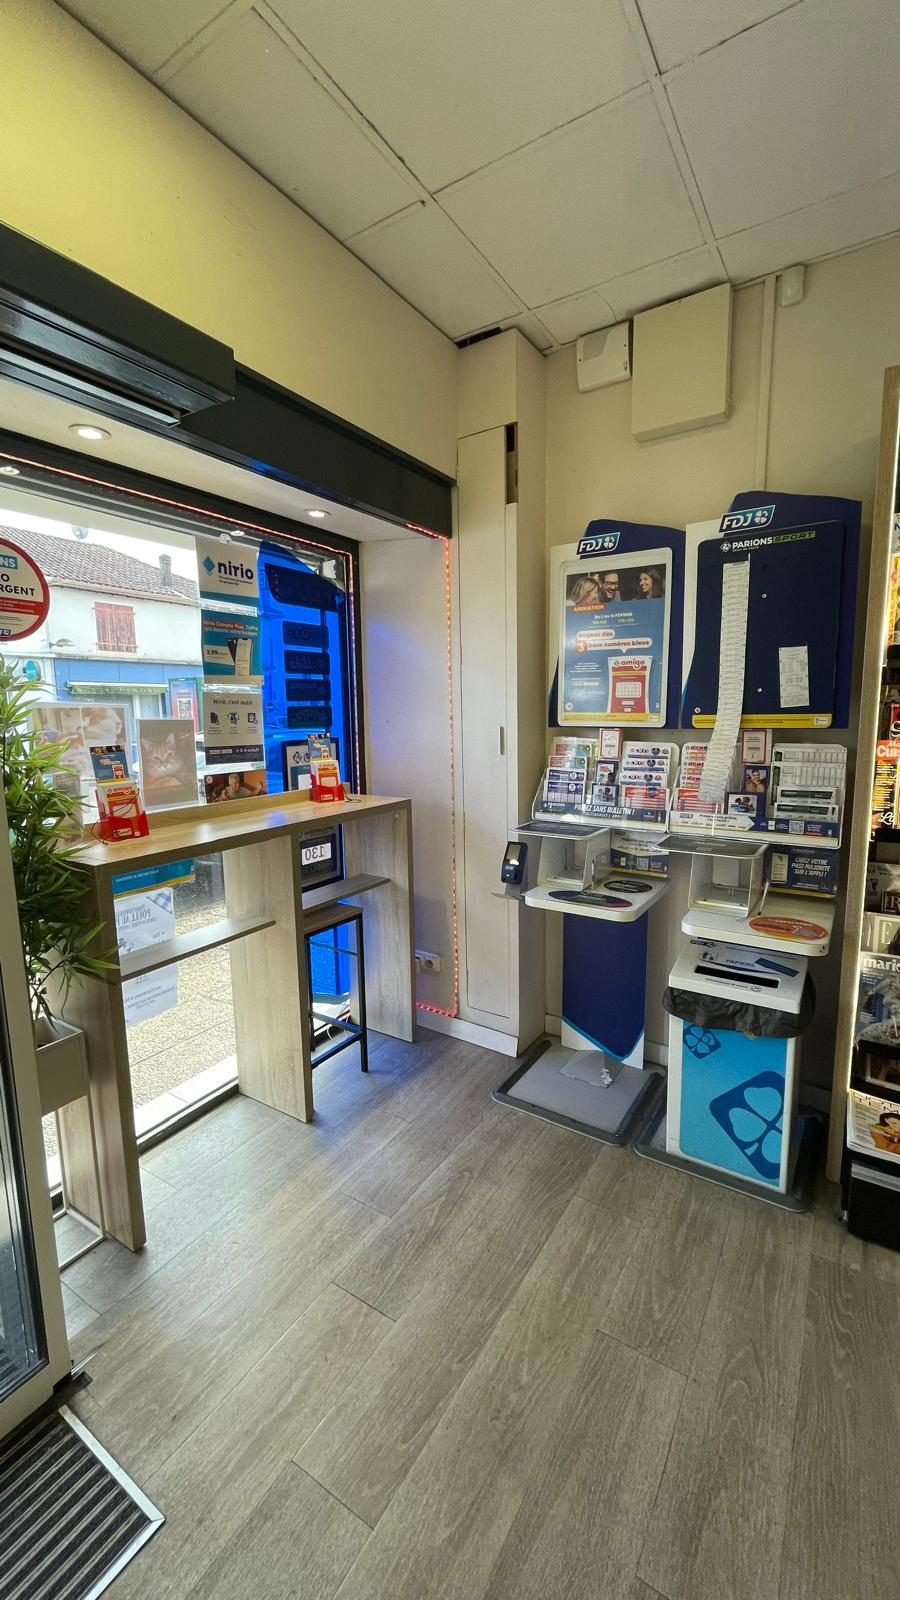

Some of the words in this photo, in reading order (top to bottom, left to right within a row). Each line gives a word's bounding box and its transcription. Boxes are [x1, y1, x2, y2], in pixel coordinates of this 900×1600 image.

[723, 512, 753, 530] FDJ
[578, 538, 603, 552] FDJ
[732, 536, 773, 550] PARIONS
[773, 532, 815, 543] SPORT
[217, 560, 254, 580] nirio
[621, 658, 645, 671] amigo
[726, 959, 756, 967] PAPIERS
